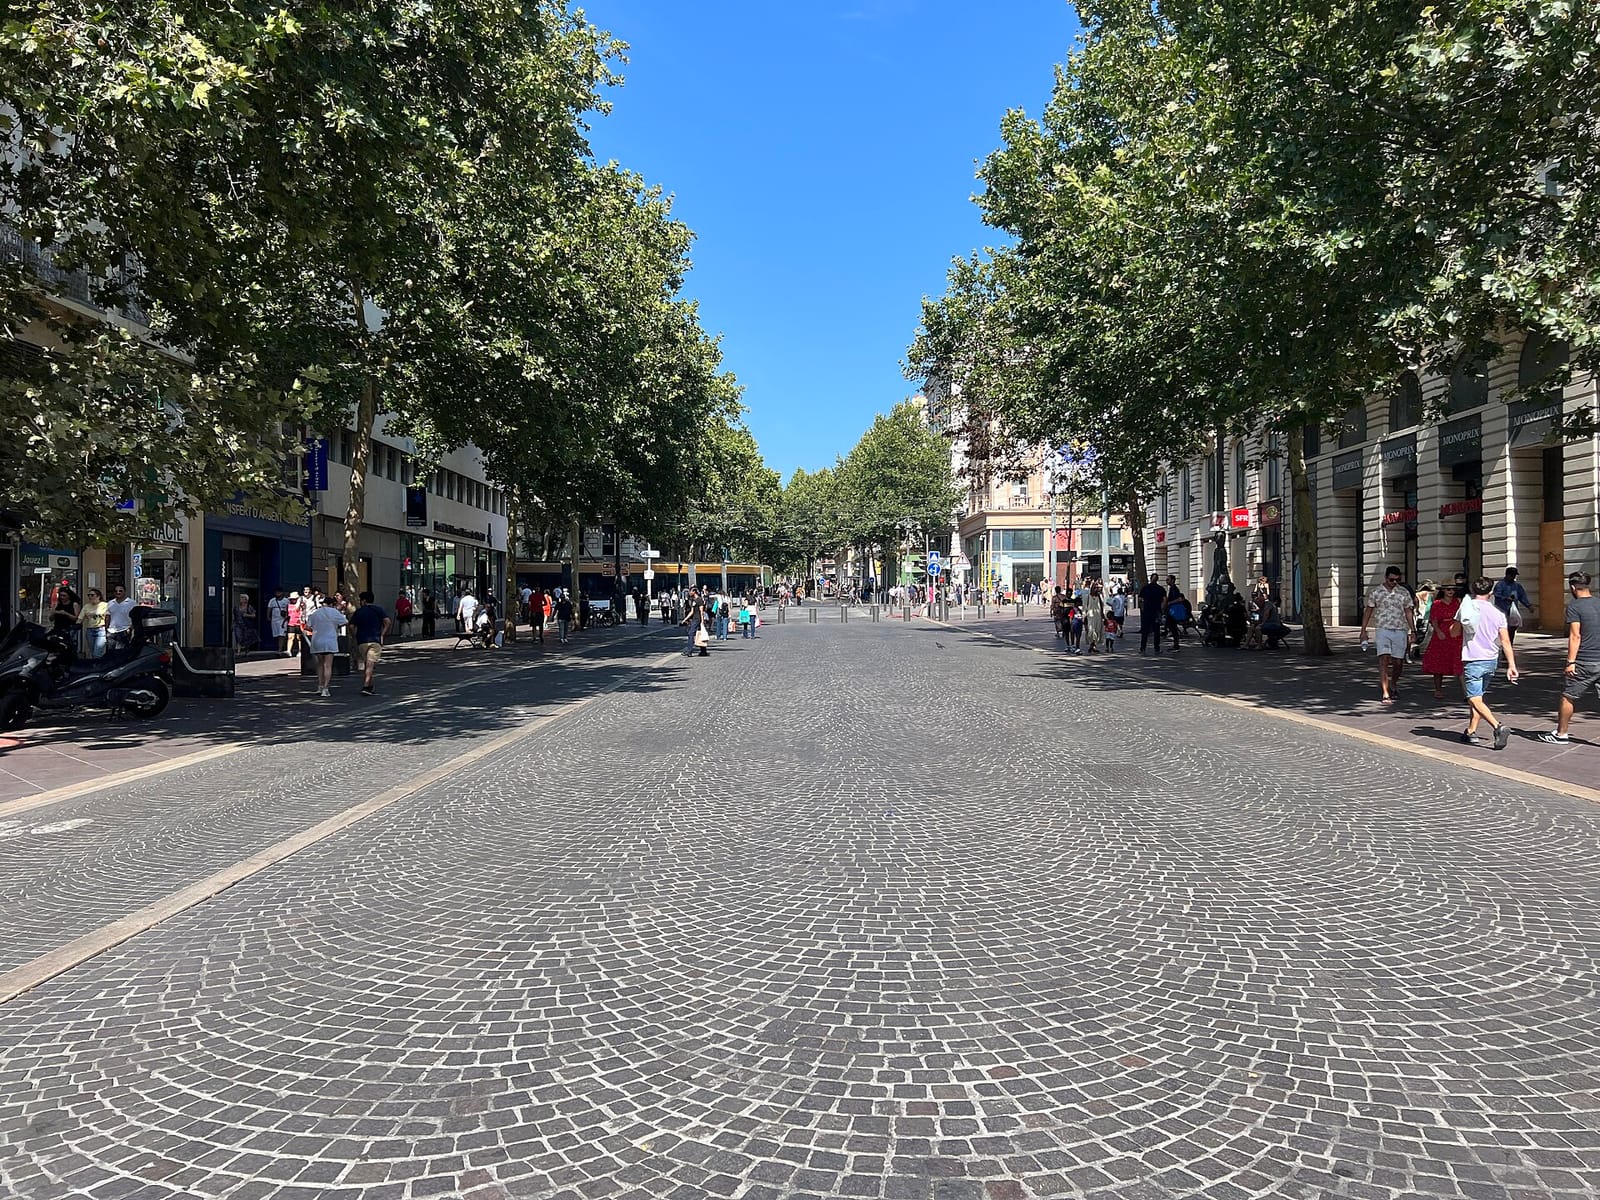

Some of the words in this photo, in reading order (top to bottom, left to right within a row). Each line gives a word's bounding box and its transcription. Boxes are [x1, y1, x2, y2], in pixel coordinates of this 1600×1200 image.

[1512, 404, 1560, 427] MONOPRIX
[1442, 427, 1481, 446] MONOPRIX
[1383, 444, 1415, 461] MONOPRIX
[1335, 460, 1361, 473] MONOPRIX
[1234, 514, 1249, 522] SFR
